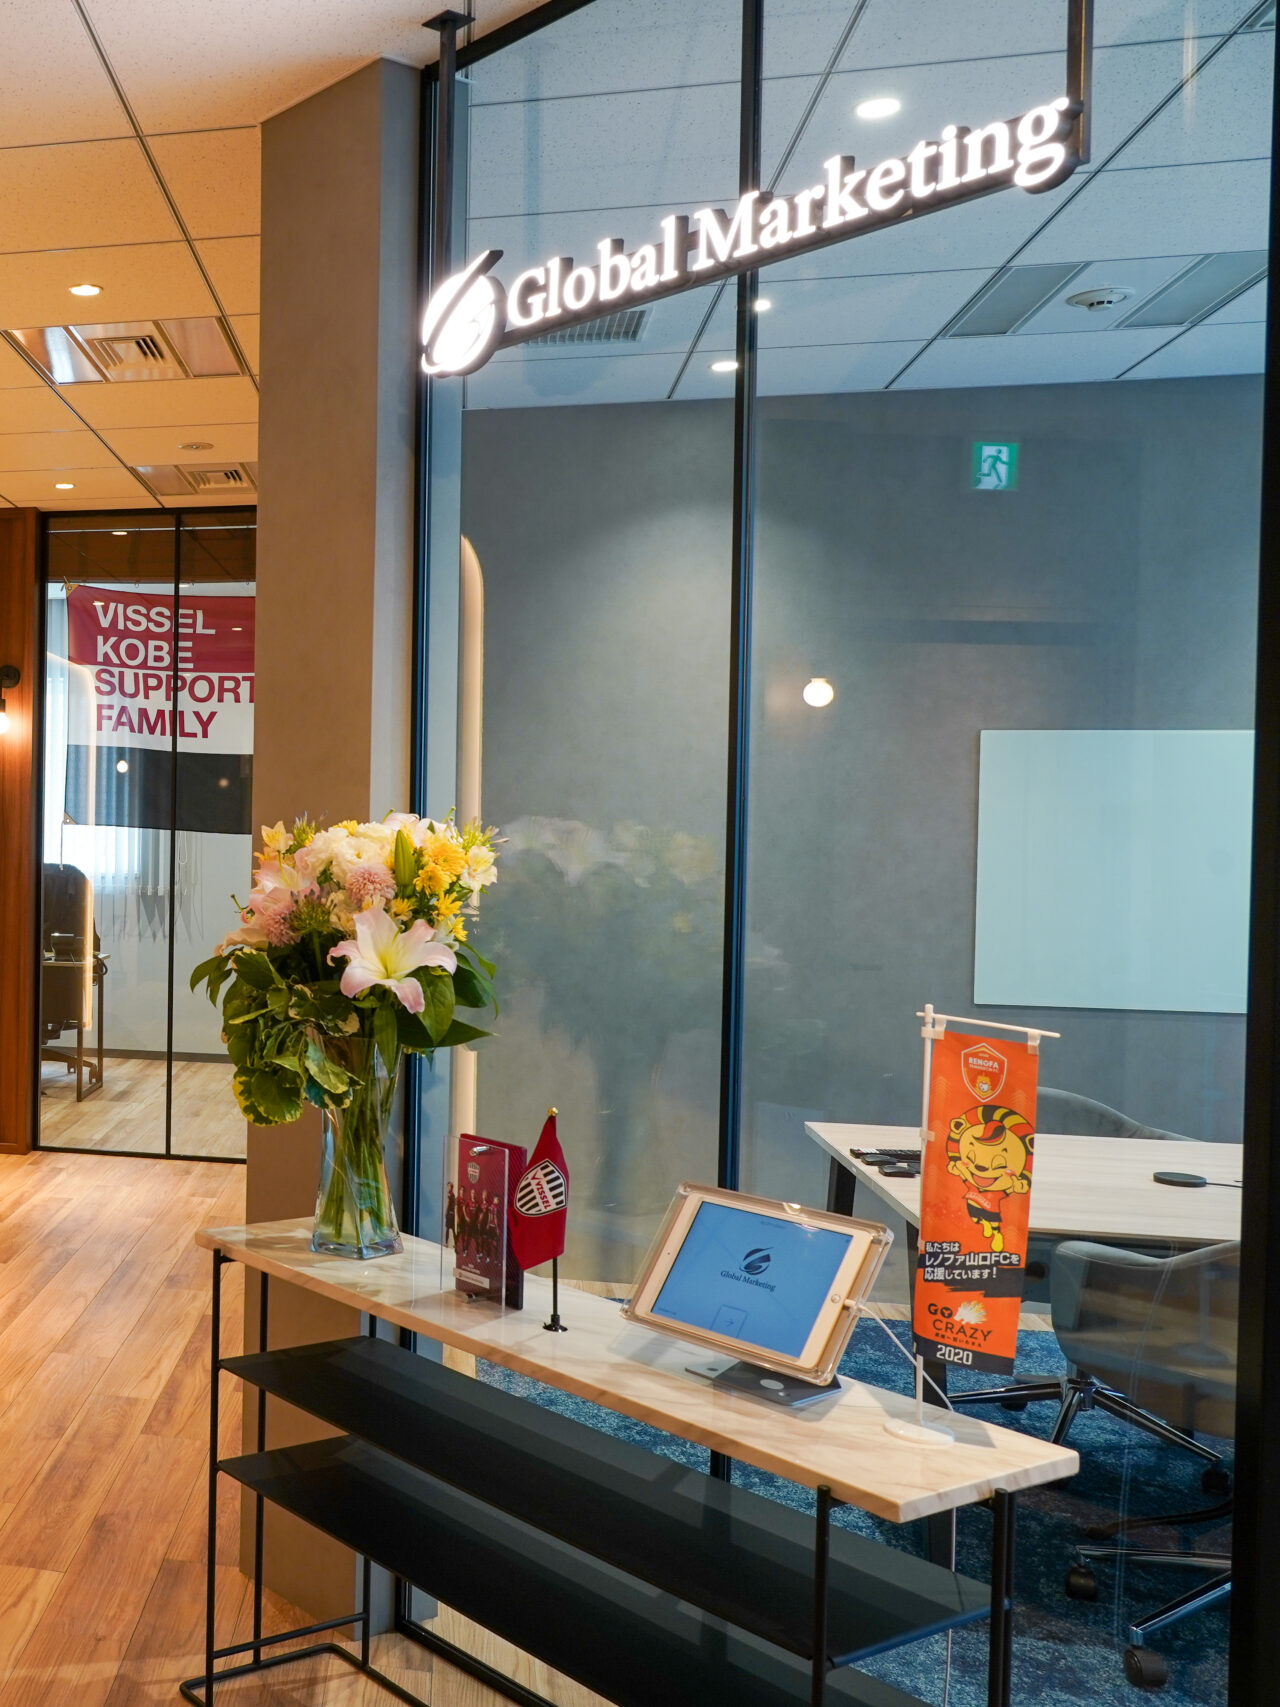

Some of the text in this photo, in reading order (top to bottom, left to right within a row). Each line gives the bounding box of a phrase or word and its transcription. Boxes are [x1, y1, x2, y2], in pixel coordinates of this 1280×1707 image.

[505, 96, 1072, 330] Global Marketing
[94, 601, 216, 635] VISSEL
[96, 635, 194, 669] KOBE
[925, 1241, 960, 1252] 私たちは
[925, 1252, 1020, 1266] レノファ山口FCを
[720, 1270, 777, 1293] Global Marketing
[932, 1319, 993, 1342] CRAZY
[936, 1344, 972, 1365] 2020
